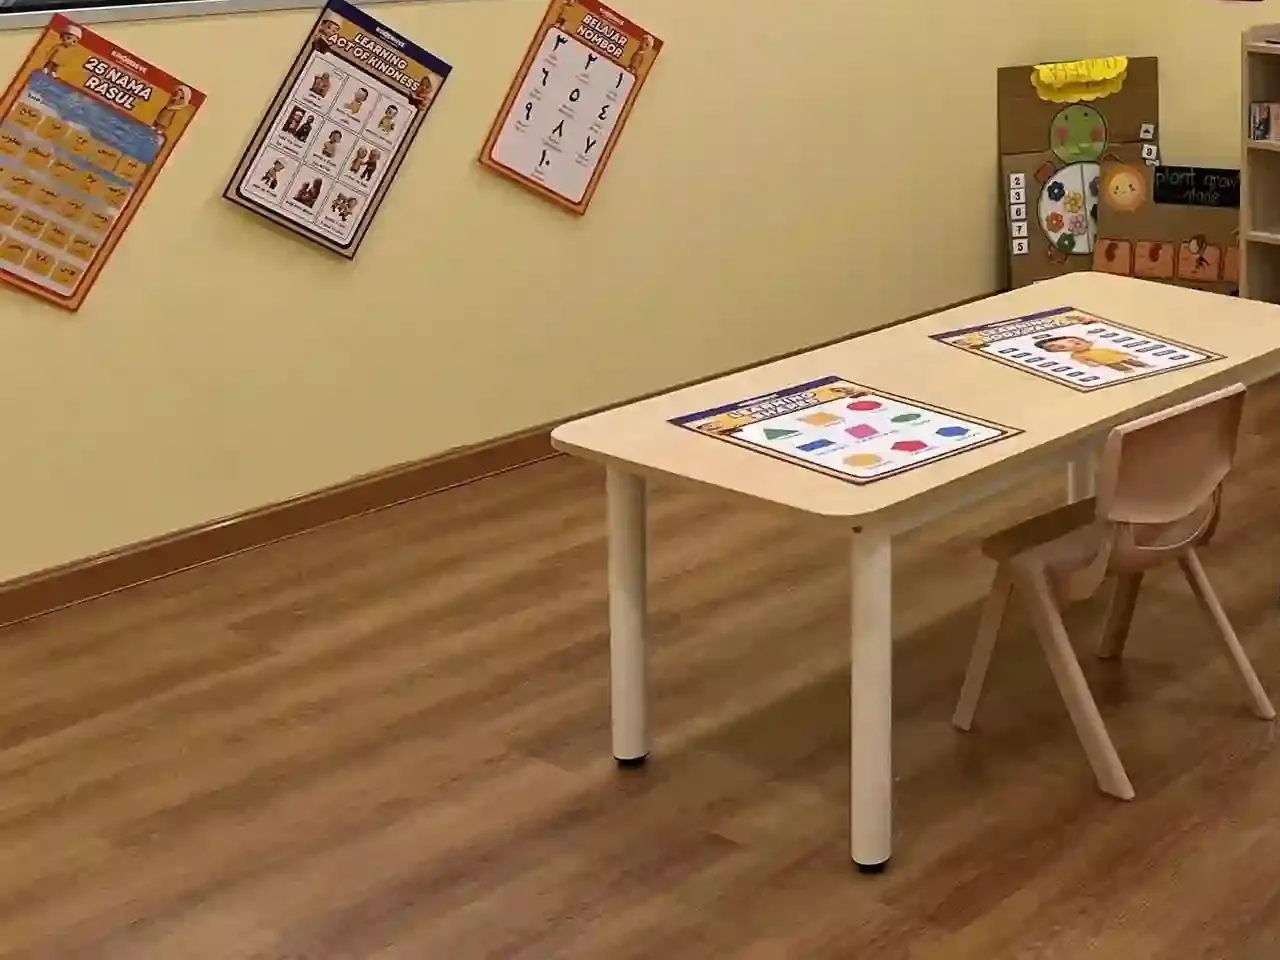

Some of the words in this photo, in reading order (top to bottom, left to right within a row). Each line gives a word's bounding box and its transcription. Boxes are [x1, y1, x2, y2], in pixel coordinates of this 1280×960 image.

[576, 24, 624, 59] NOMBOR
[582, 12, 629, 48] BELAJAR
[329, 33, 355, 52] ACT
[352, 46, 370, 61] OF
[367, 55, 420, 91] KINDNESS
[354, 32, 408, 70] LEARNING
[83, 57, 108, 76] 25
[104, 67, 153, 101] NAMA
[84, 75, 136, 110] RASUL
[1156, 167, 1196, 189] plant
[1017, 242, 1024, 252] 5
